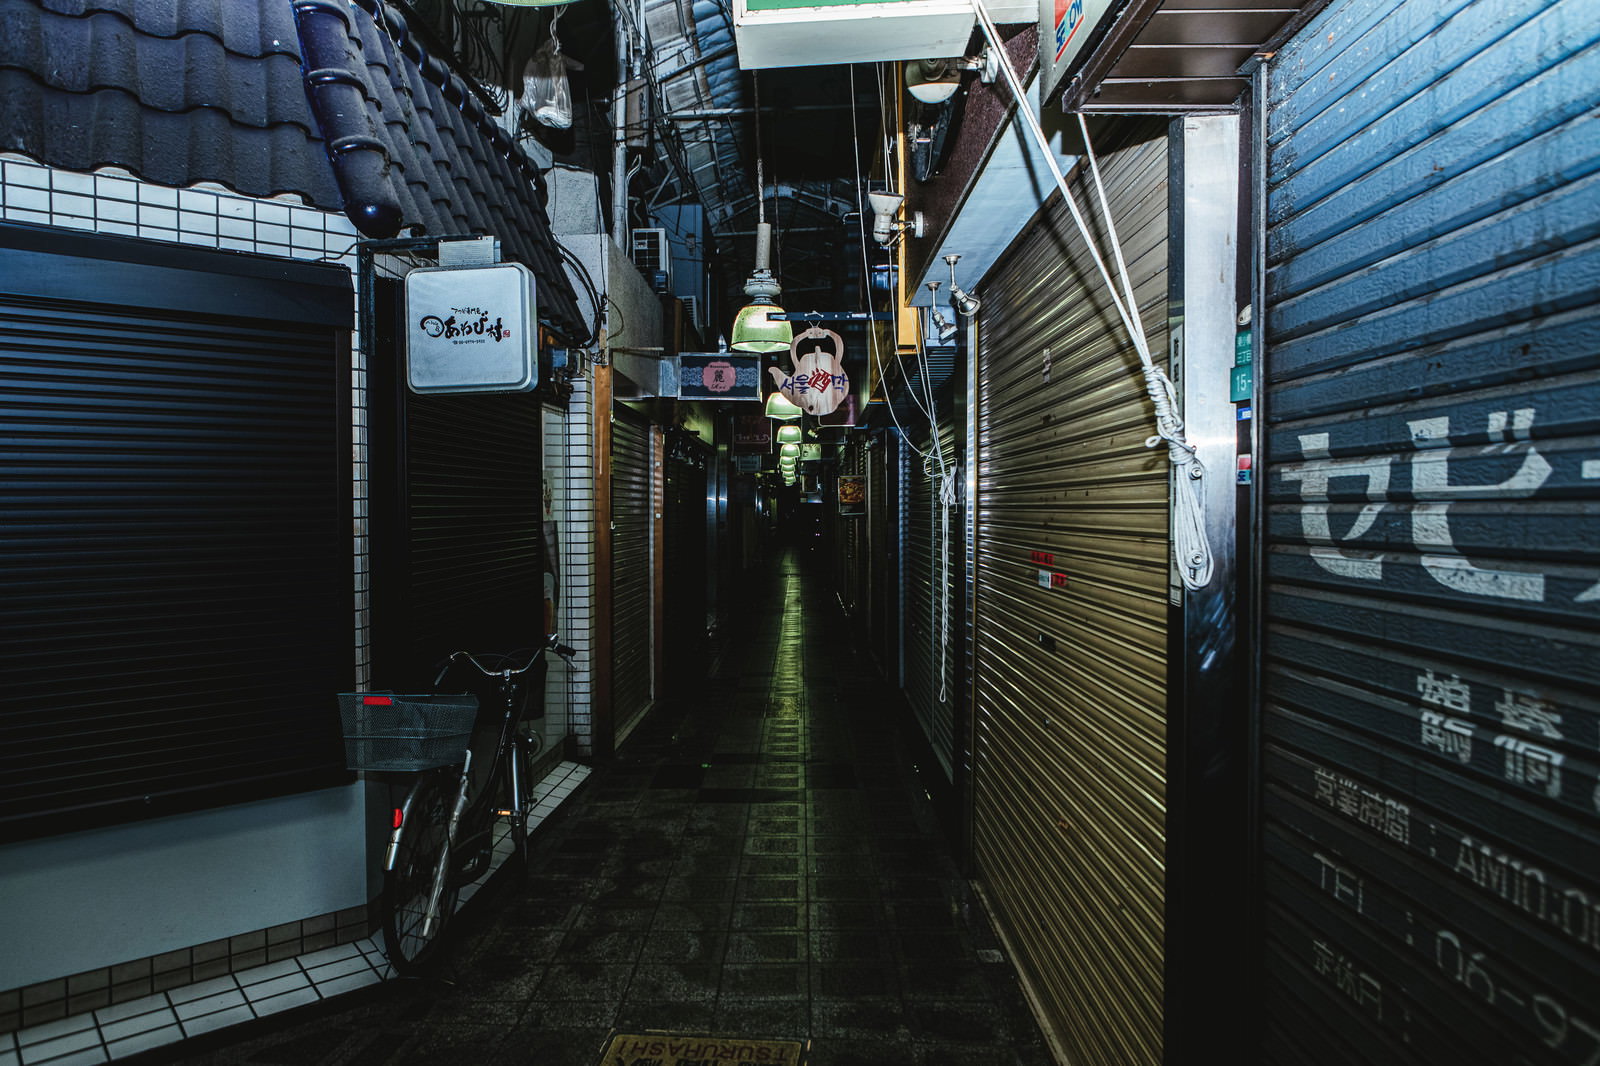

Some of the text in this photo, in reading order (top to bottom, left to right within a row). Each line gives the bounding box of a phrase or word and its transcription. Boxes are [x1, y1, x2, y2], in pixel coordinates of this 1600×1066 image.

[444, 311, 502, 342] あわび村
[1280, 408, 1600, 602] セビ
[1417, 668, 1600, 812] 鶴橋
[1312, 853, 1365, 913] TEL
[1454, 837, 1600, 951] AM10:0
[617, 1040, 788, 1062] TSURUHASHI
